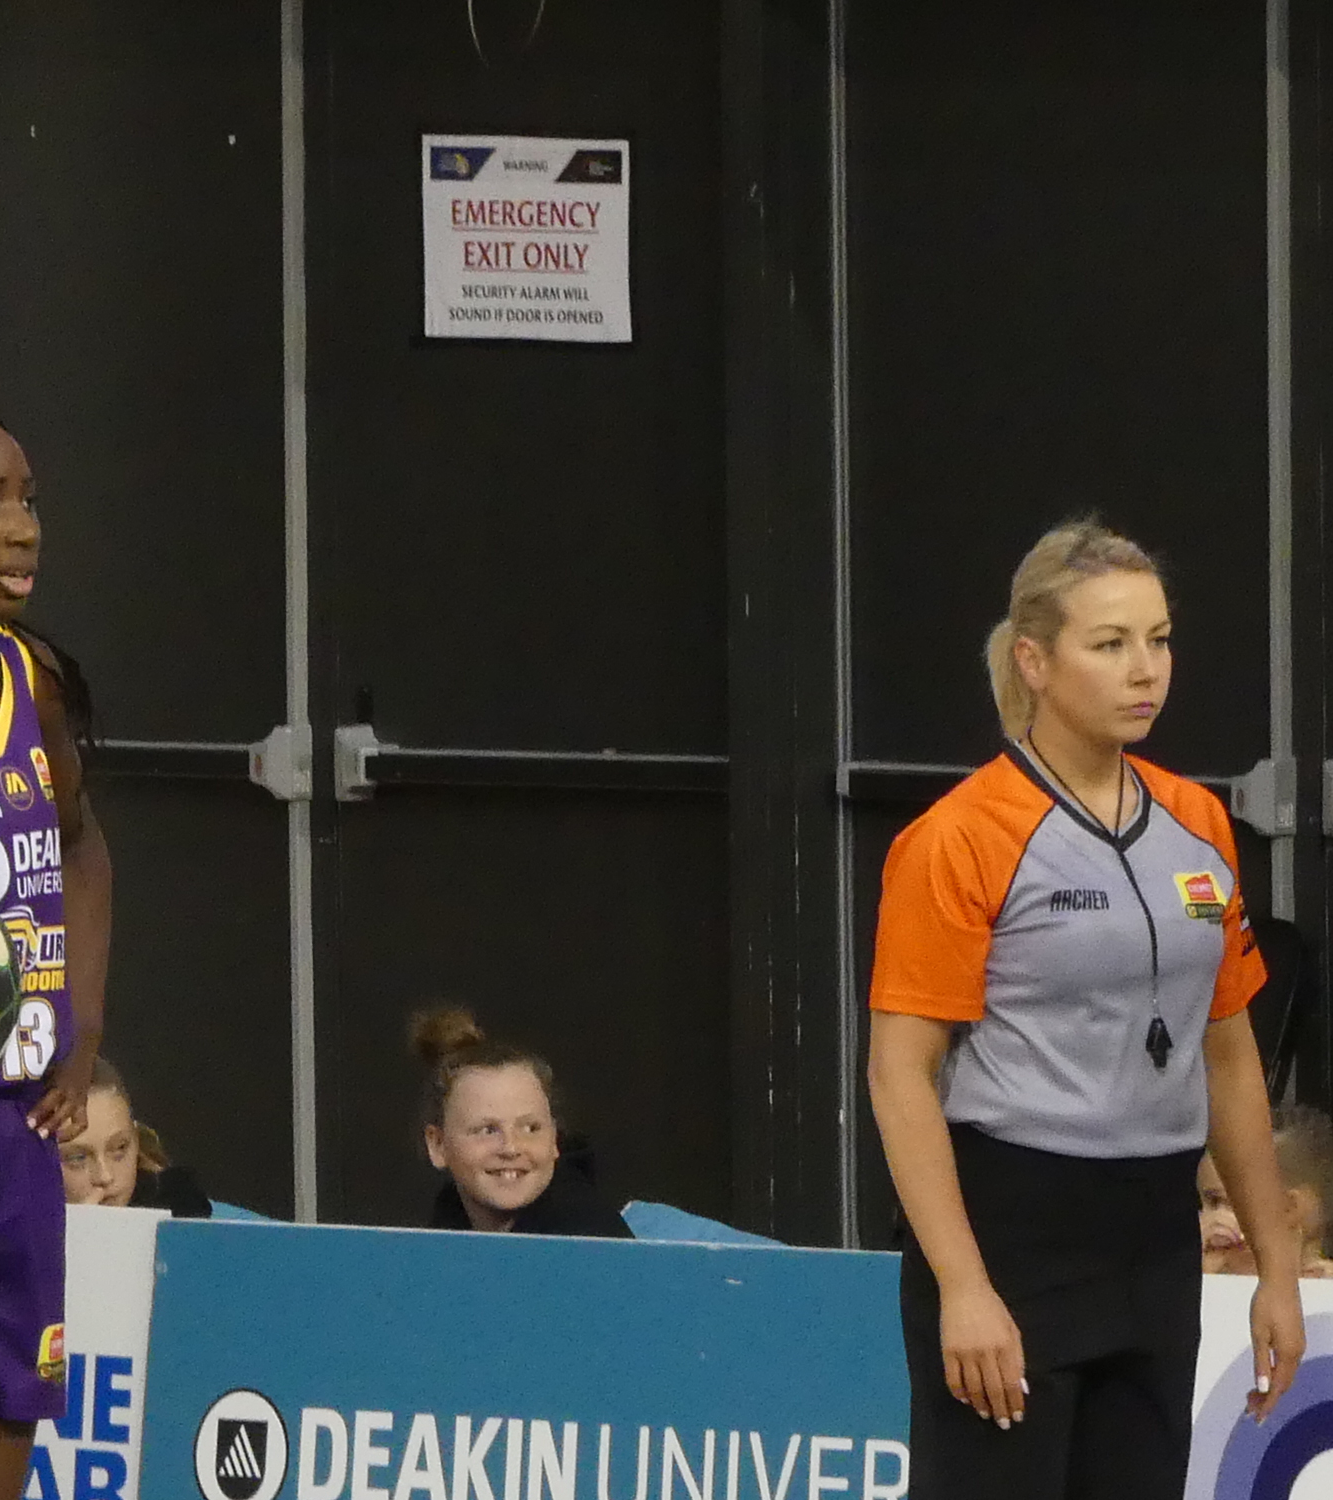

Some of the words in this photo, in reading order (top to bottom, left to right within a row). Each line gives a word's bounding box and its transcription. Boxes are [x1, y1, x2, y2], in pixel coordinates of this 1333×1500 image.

[451, 199, 600, 229] EMERGENCY
[464, 241, 516, 269] EXIT
[523, 242, 588, 271] ONLY
[462, 285, 516, 300] SECURITY
[520, 285, 561, 301] ALARM
[564, 286, 590, 302] WILL
[449, 307, 492, 322] SOUND
[494, 308, 504, 322] IF
[506, 308, 542, 323] DOOR
[544, 309, 554, 323] IS
[557, 309, 604, 324] OPENED
[1050, 888, 1110, 912] ARCHER
